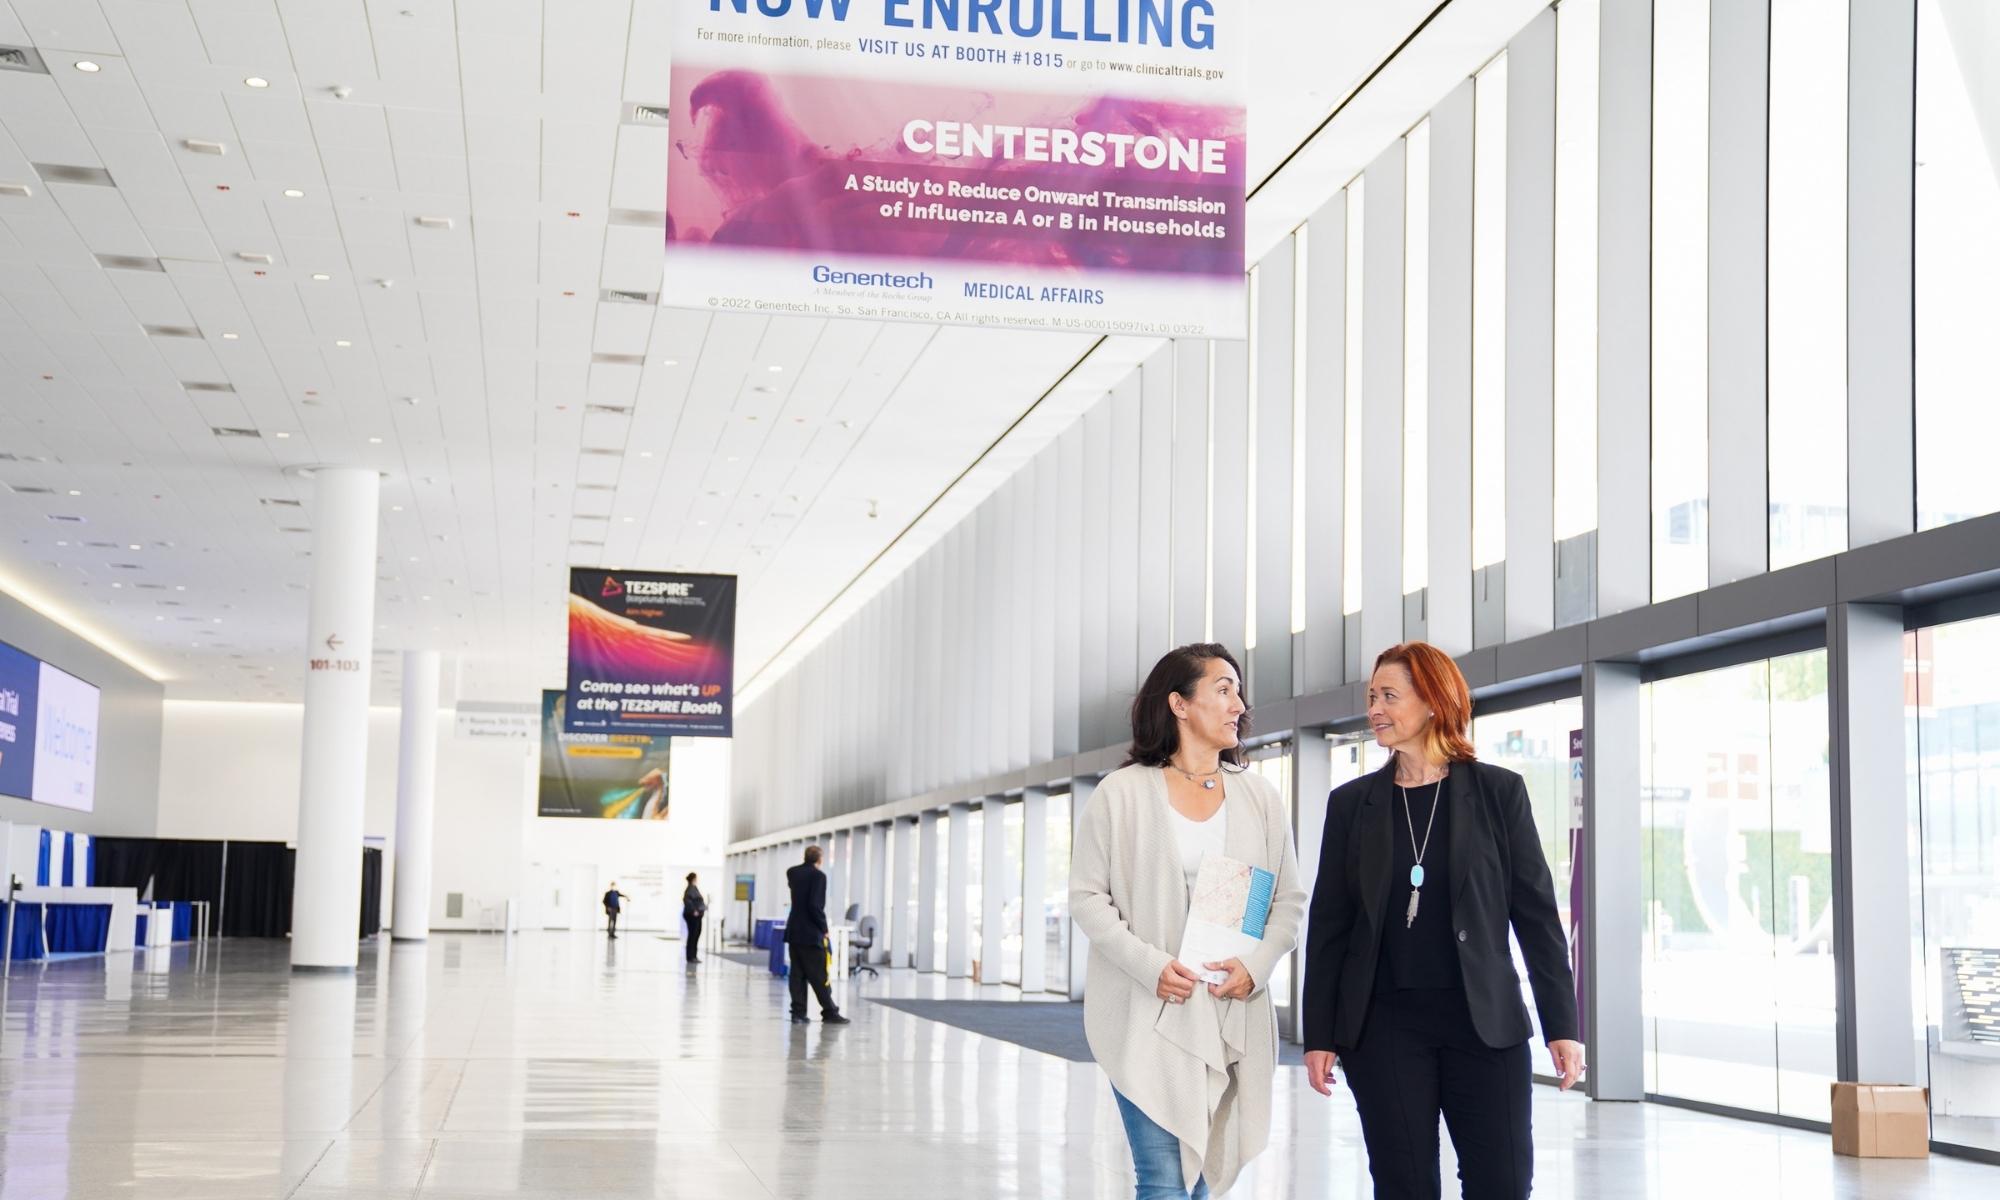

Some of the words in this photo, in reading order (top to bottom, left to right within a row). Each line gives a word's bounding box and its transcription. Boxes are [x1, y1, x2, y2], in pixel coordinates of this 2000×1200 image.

[884, 0, 1215, 50] ENROLLING
[697, 28, 714, 40] For
[717, 32, 744, 43] more
[748, 34, 813, 49] information,
[817, 37, 851, 51] please
[859, 38, 899, 55] VISIT
[905, 42, 925, 58] US
[931, 44, 950, 59] AT
[955, 46, 1007, 64] BOOTH
[1013, 51, 1063, 68] #1815
[1066, 59, 1076, 69] or
[1081, 60, 1093, 72] go
[1096, 59, 1106, 70] to
[1109, 61, 1224, 80] www.clinicaltrials.gov
[903, 119, 1227, 174] CENTERSTONE
[844, 174, 859, 191] A
[862, 175, 920, 198] Study
[923, 179, 944, 196] to
[948, 180, 1021, 202] Reduce
[1024, 186, 1099, 208] Onward
[1103, 191, 1226, 215] Transmission
[879, 201, 903, 218] of
[908, 202, 1007, 225] Influenza
[1013, 209, 1027, 226] A
[1032, 214, 1054, 228] or
[1060, 213, 1073, 230] B
[1079, 213, 1097, 231] in
[1104, 215, 1225, 239] Households
[813, 265, 933, 289] Genentech
[964, 282, 1035, 301] MEDICAL
[1040, 287, 1104, 304] AFFAIRS
[721, 298, 751, 309] 2022
[754, 299, 810, 312] Genentech
[814, 303, 833, 314] Inc.
[837, 305, 854, 315] So.
[858, 306, 877, 316] San
[881, 308, 933, 321] Francisco,
[937, 310, 951, 321] CA
[955, 312, 968, 321] All
[971, 313, 1000, 325] rights
[1003, 316, 1048, 327] reserved.
[310, 659, 360, 672] 101-103
[580, 680, 623, 694] Come
[625, 683, 650, 694] see
[652, 682, 699, 697] what's
[702, 685, 721, 697] UP
[577, 698, 593, 710] at
[594, 698, 619, 711] the
[621, 699, 681, 713] TEZSPIRE
[681, 701, 723, 715] Booth
[558, 733, 608, 743] DISCOVER
